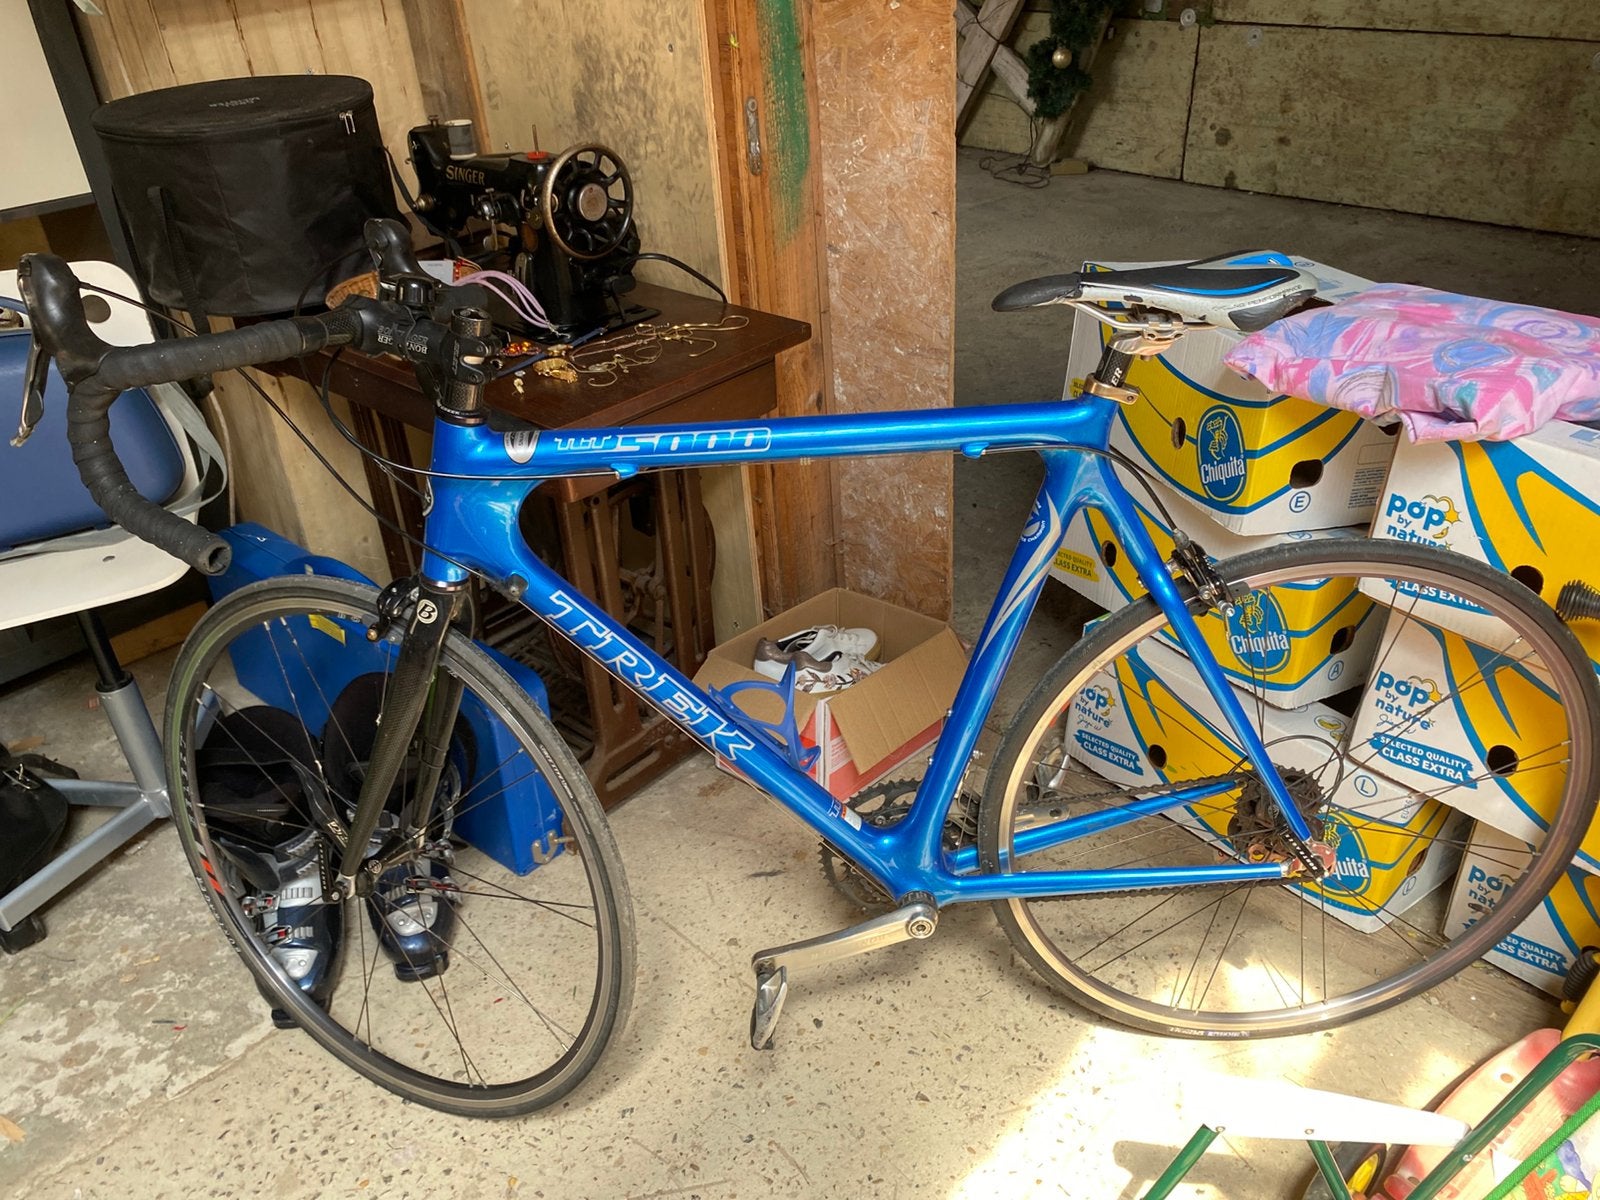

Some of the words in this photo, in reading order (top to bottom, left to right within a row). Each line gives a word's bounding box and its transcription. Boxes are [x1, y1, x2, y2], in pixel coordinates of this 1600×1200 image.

[446, 165, 485, 186] SINGER
[616, 429, 768, 451] 5000
[1201, 457, 1245, 486] Chiquita
[1295, 495, 1305, 508] E
[1386, 493, 1446, 531] pop
[1397, 514, 1412, 528] by
[1072, 564, 1092, 577] EXTRA
[1230, 631, 1289, 657] Chiquita
[549, 590, 755, 761] TREK
[1375, 670, 1430, 707] pop
[1385, 690, 1399, 703] by
[1080, 696, 1089, 706] by
[1075, 703, 1111, 728] nature
[1375, 698, 1430, 730] nature
[1082, 732, 1110, 749] SELECTED
[1110, 745, 1136, 760] QUALITY
[1083, 741, 1107, 757] CLASS
[1109, 753, 1135, 770] EXTRA
[1380, 736, 1424, 756] SELECTED
[1426, 751, 1467, 770] QUALITY
[1382, 747, 1420, 767] CLASS
[1422, 760, 1464, 781] EXTRA
[1360, 779, 1369, 794] L
[1333, 857, 1370, 881] quita
[1469, 889, 1496, 908] nat
[1477, 884, 1491, 895] by
[1517, 949, 1559, 971] EXTRA
[1520, 942, 1560, 961] QUALITY
